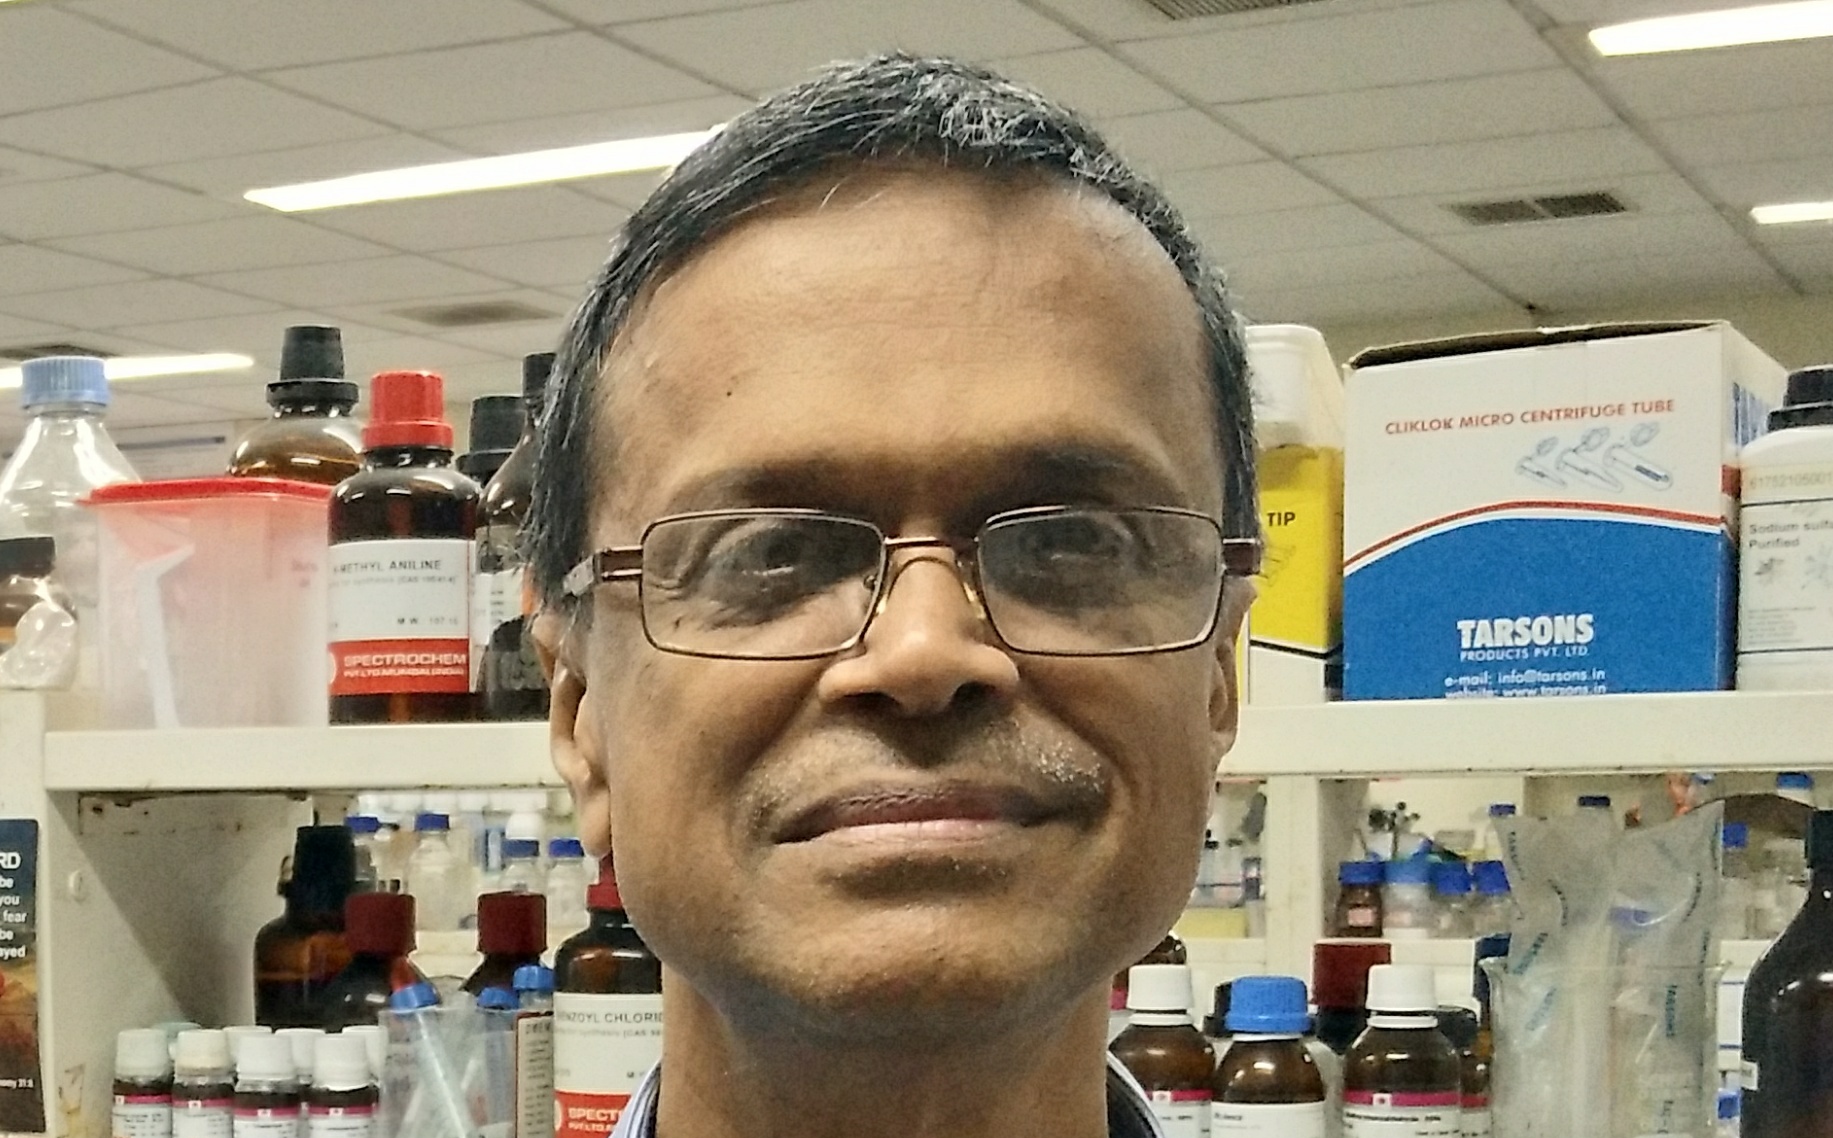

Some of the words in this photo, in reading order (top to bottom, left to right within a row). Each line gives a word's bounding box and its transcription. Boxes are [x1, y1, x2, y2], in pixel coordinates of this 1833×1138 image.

[1385, 417, 1454, 435] CLIKLOK
[1459, 412, 1515, 428] MICRO
[1520, 403, 1625, 424] CENTRIFUGE
[1631, 398, 1675, 415] TUBE
[1266, 511, 1296, 527] TIP
[1749, 523, 1799, 536] Sodium
[1749, 536, 1800, 549] Purified
[389, 559, 442, 571] ANILINE
[1456, 613, 1594, 649] TARSONS
[343, 653, 467, 668] SPECTROCHEM
[1460, 648, 1529, 662] PRODUCTS
[1534, 646, 1561, 658] PVT.
[1444, 671, 1493, 687] e-mail:
[1498, 667, 1606, 684] info@tarsons.in
[3, 909, 28, 923] fear
[567, 1107, 624, 1121] SPECT
